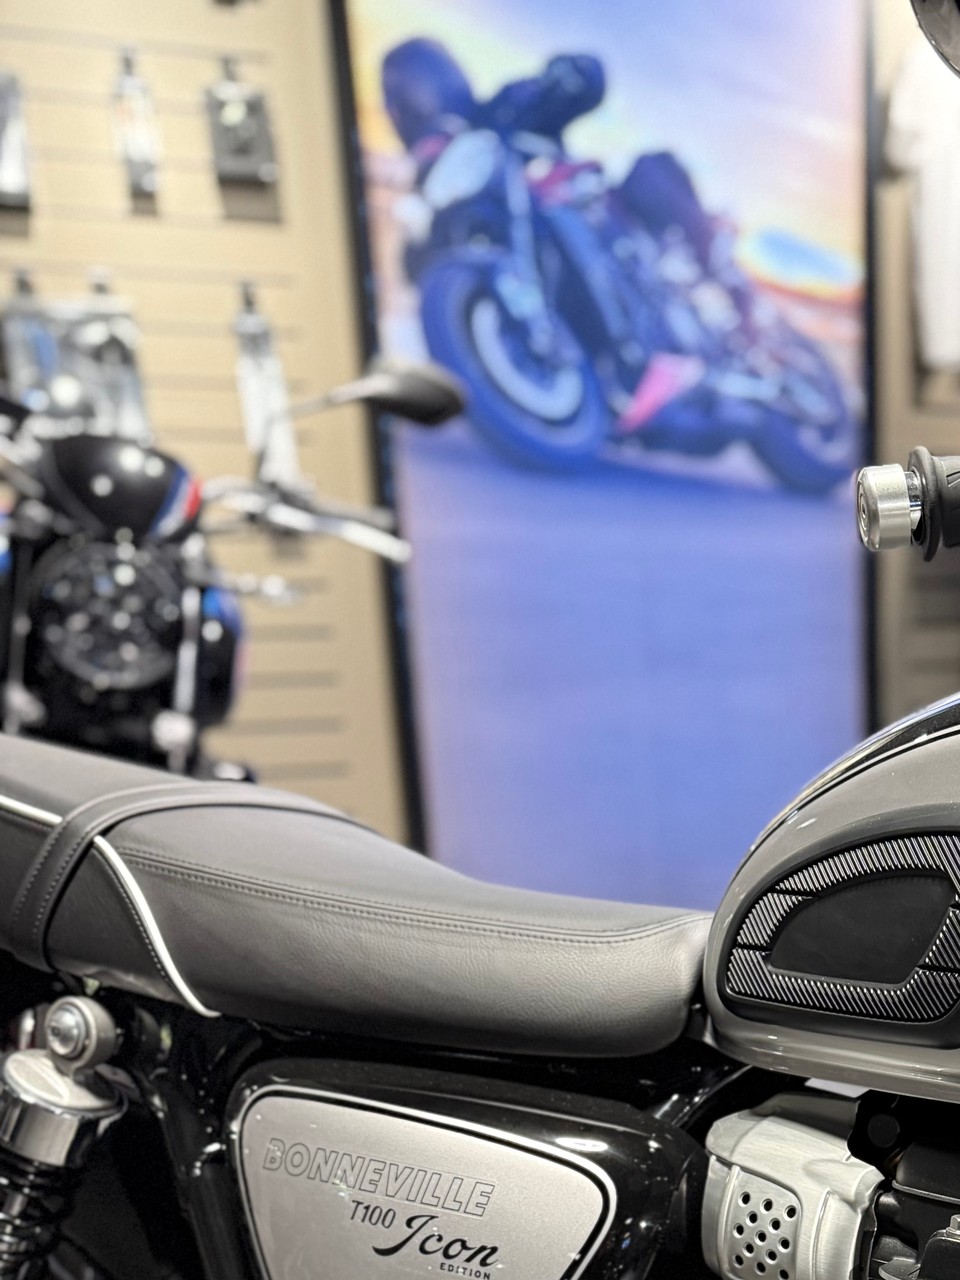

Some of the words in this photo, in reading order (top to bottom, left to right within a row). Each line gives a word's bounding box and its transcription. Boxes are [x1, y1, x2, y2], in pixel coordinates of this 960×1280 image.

[263, 1138, 495, 1217] BONNEVILLE
[351, 1200, 397, 1229] T100
[372, 1214, 499, 1268] Icon
[440, 1263, 491, 1280] EDITION
